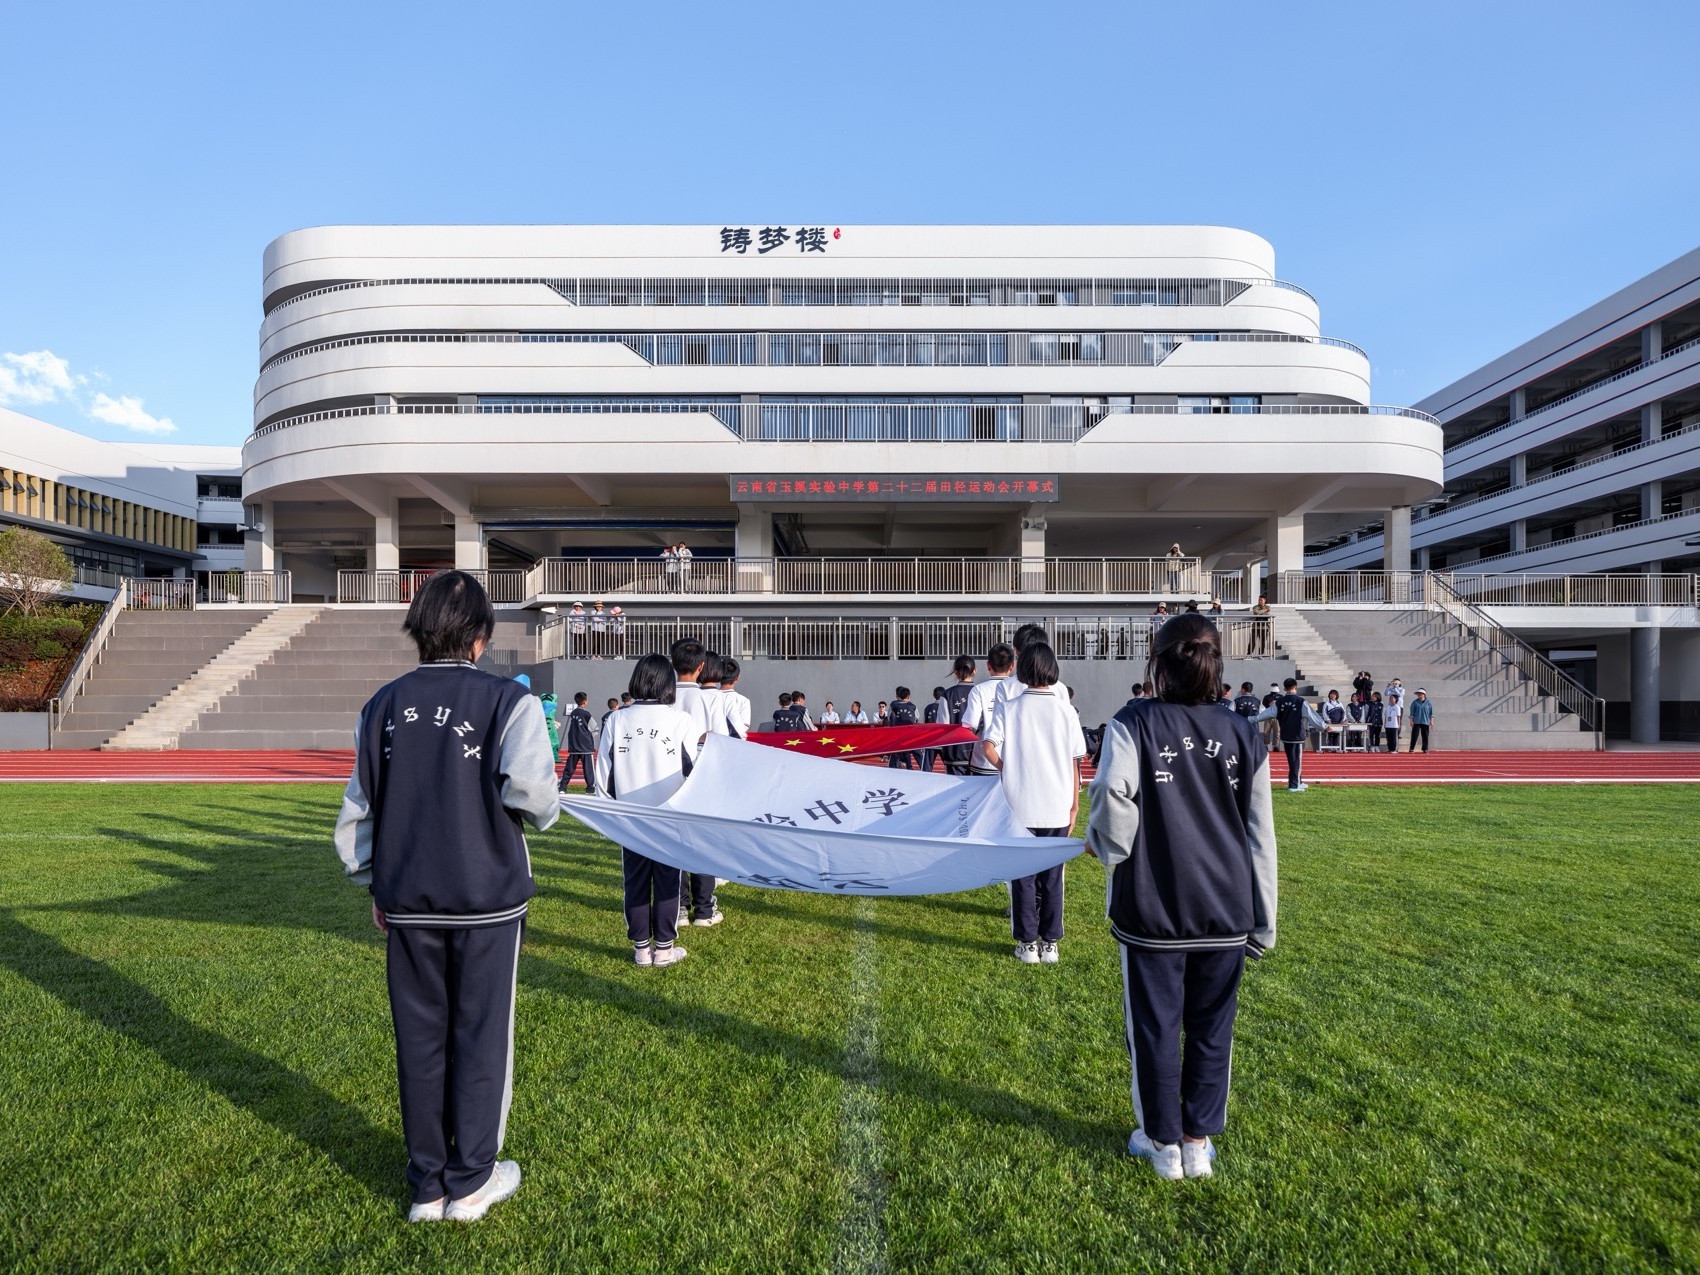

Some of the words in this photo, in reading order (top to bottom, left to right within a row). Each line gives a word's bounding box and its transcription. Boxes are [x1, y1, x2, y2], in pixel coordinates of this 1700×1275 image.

[720, 226, 829, 254] 铸梦楼
[736, 480, 1054, 494] 云南省玉溪实验中学第二十二届田径运动会开幕式
